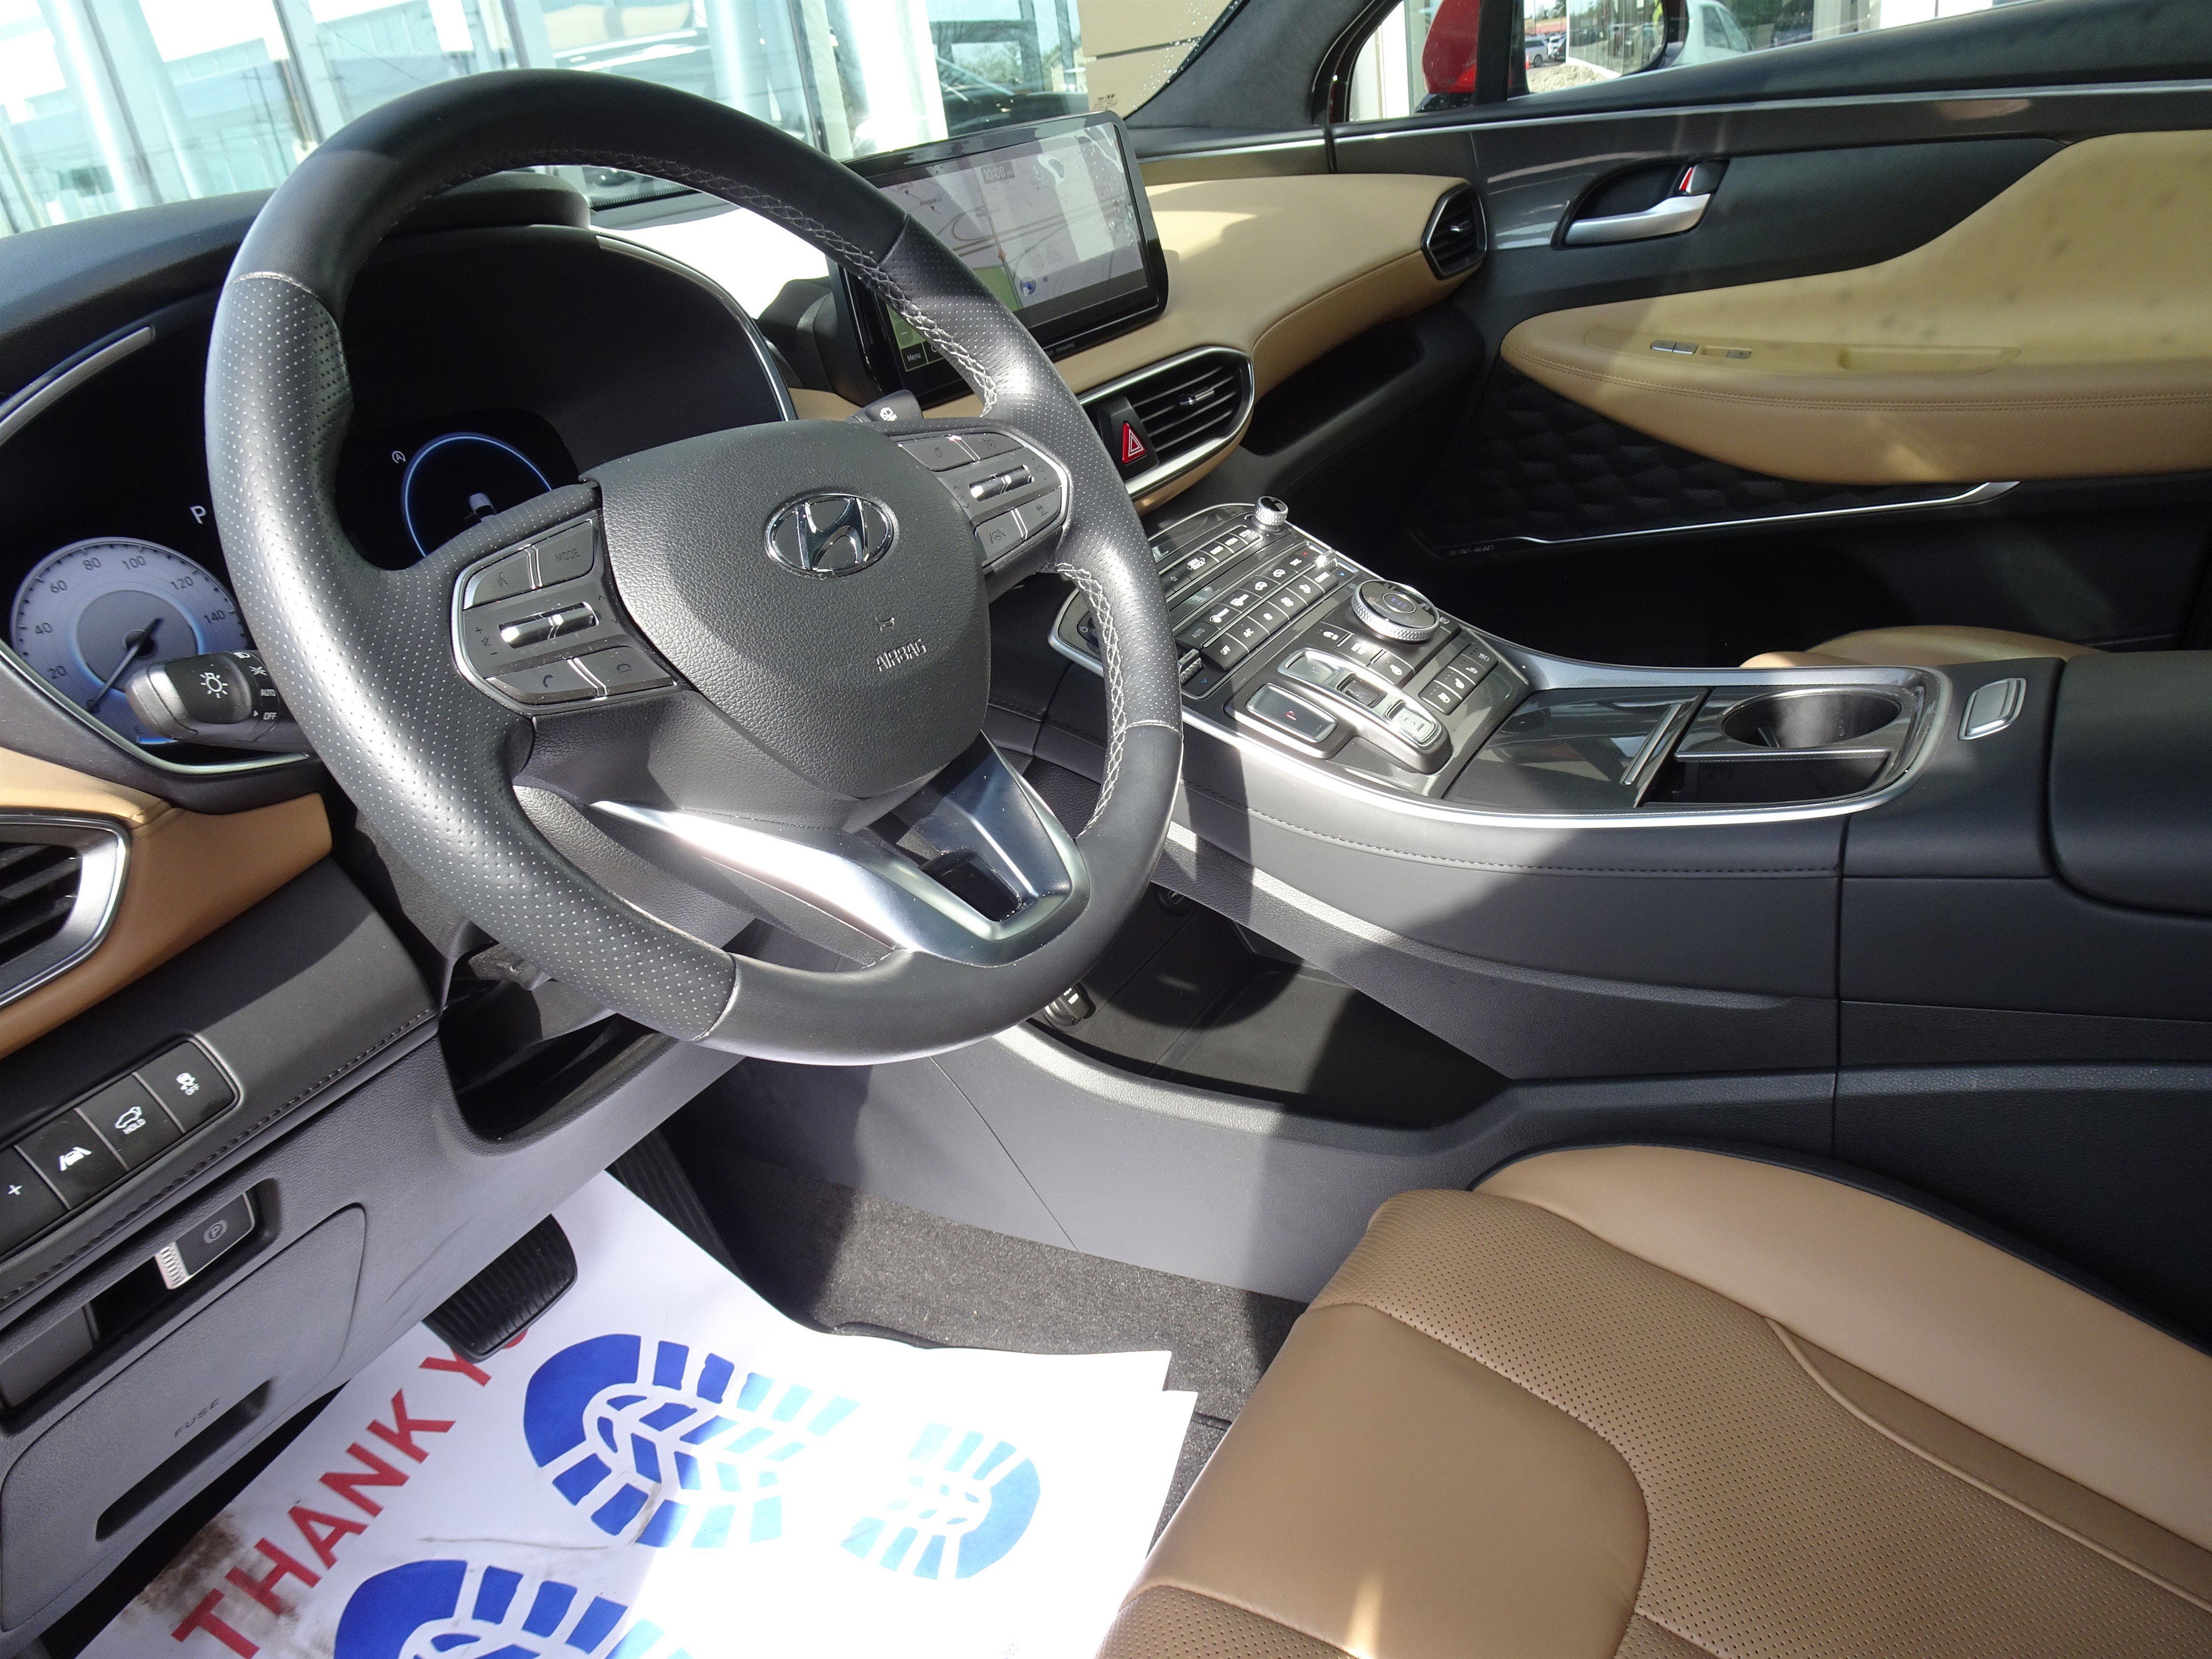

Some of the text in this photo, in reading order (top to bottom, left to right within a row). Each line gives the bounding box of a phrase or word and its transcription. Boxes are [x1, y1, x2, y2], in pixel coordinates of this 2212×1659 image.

[983, 165, 1006, 180] 10:08
[907, 353, 921, 362] Menu
[190, 505, 206, 524] P
[555, 548, 580, 562] MODE
[84, 557, 102, 571] 80
[122, 555, 146, 570] 100
[50, 579, 68, 593] 60
[170, 576, 194, 591] 120
[203, 609, 226, 624] 140
[35, 622, 52, 635] 40
[1191, 628, 1205, 638] AUTO
[876, 638, 927, 672] AIRBAG
[48, 665, 66, 679] 20
[260, 689, 276, 697] AUTO
[173, 1397, 220, 1438] FUSE
[171, 1388, 456, 1659] THANK
